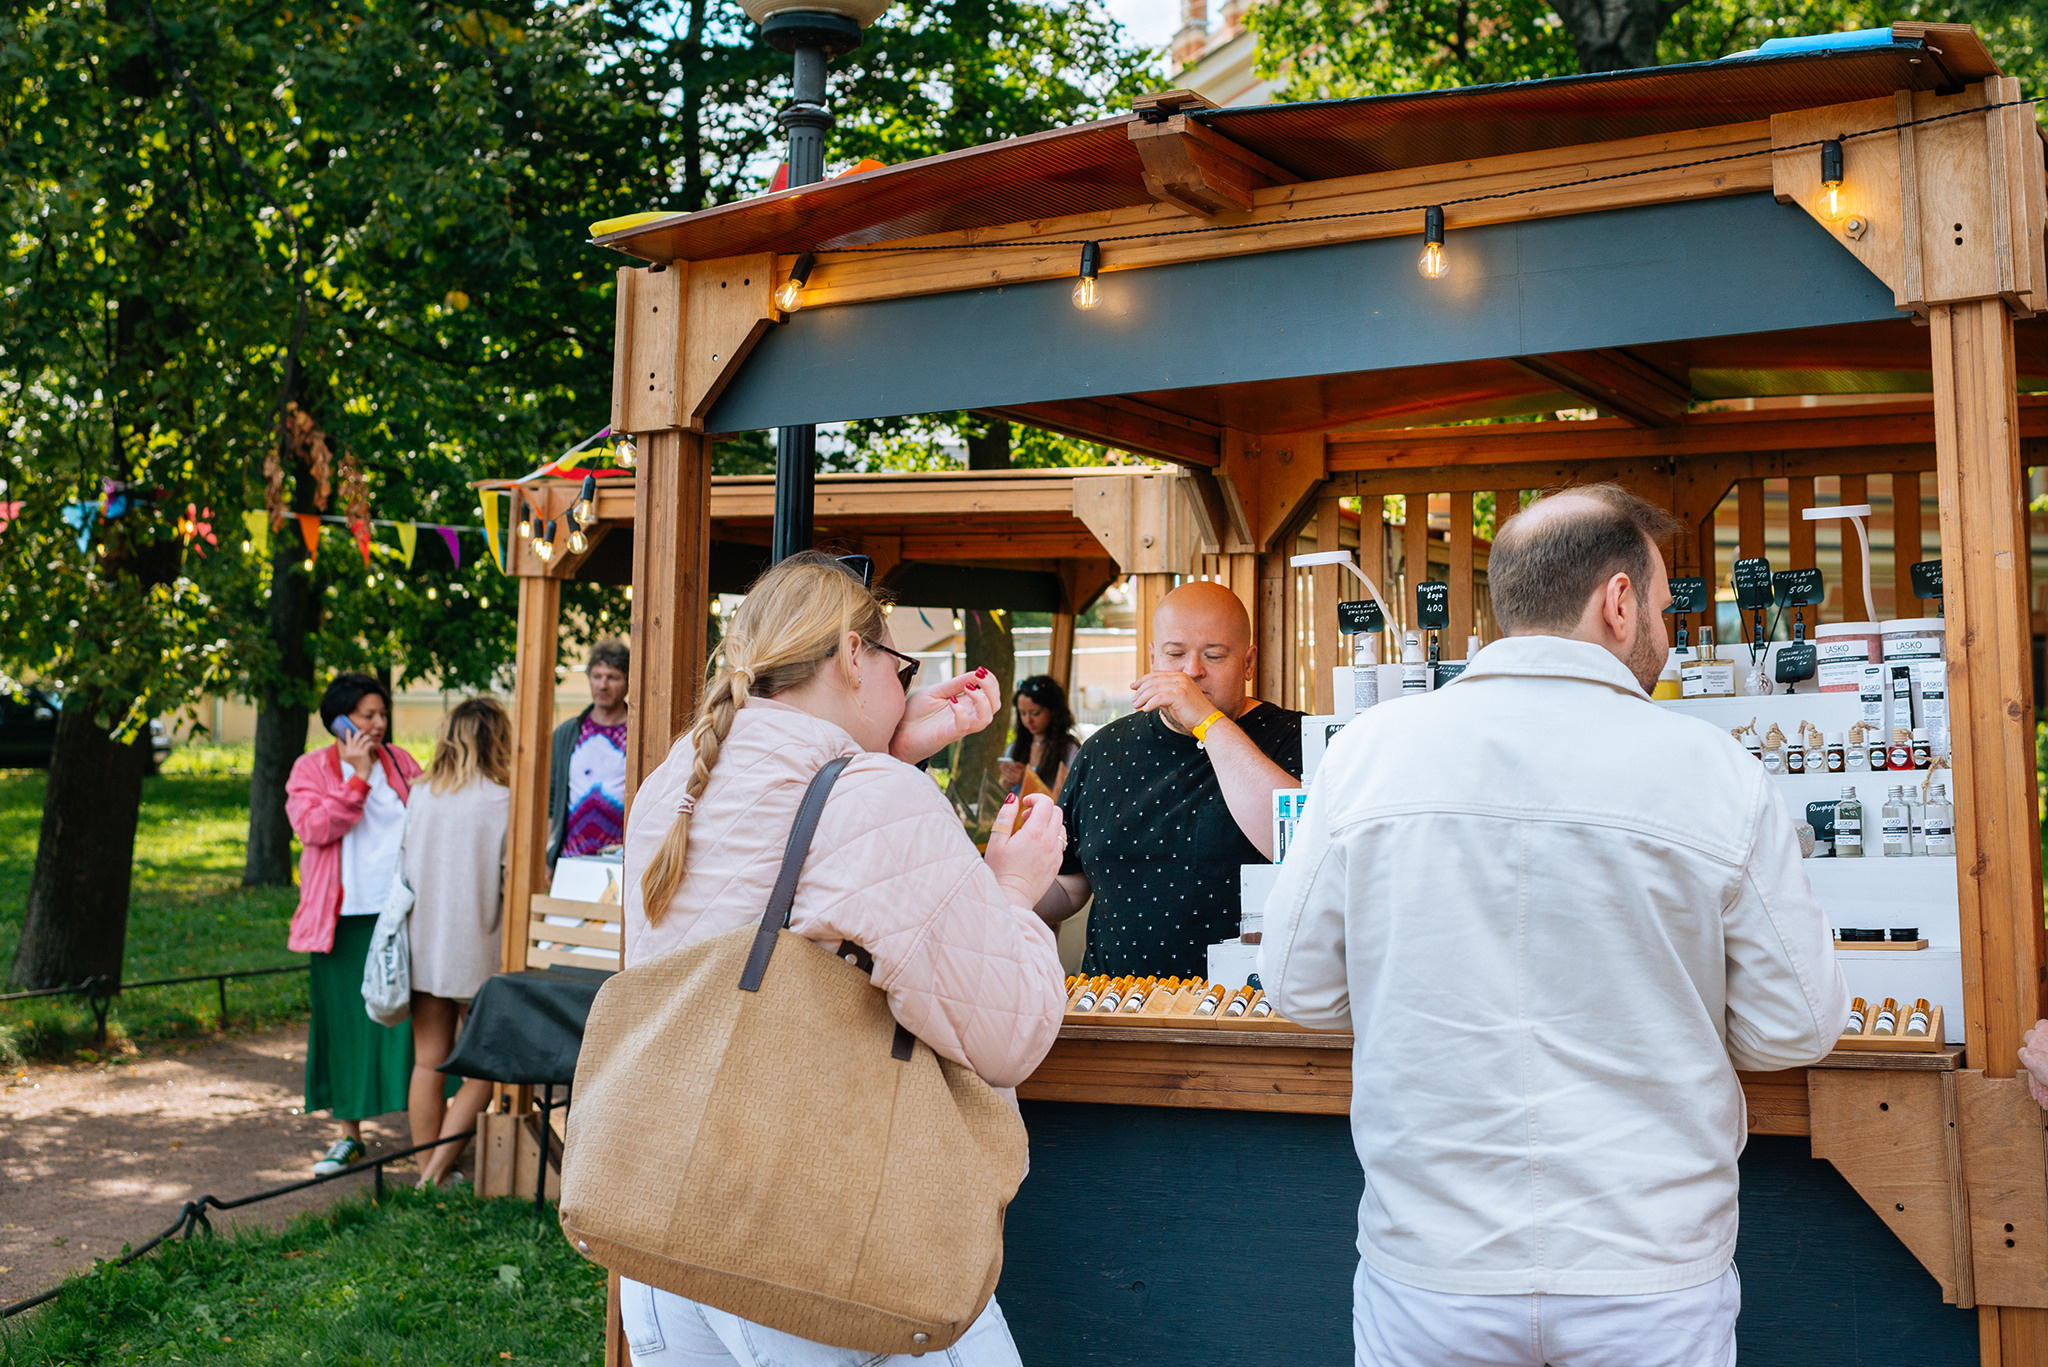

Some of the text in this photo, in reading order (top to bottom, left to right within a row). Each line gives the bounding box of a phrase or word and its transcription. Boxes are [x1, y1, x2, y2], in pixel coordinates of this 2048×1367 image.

[1931, 577, 1943, 585] 50
[1788, 584, 1813, 595] 500
[1426, 604, 1443, 612] 400
[1354, 615, 1370, 623] 600
[1825, 644, 1850, 653] LASKO
[1896, 641, 1923, 650] LASKO
